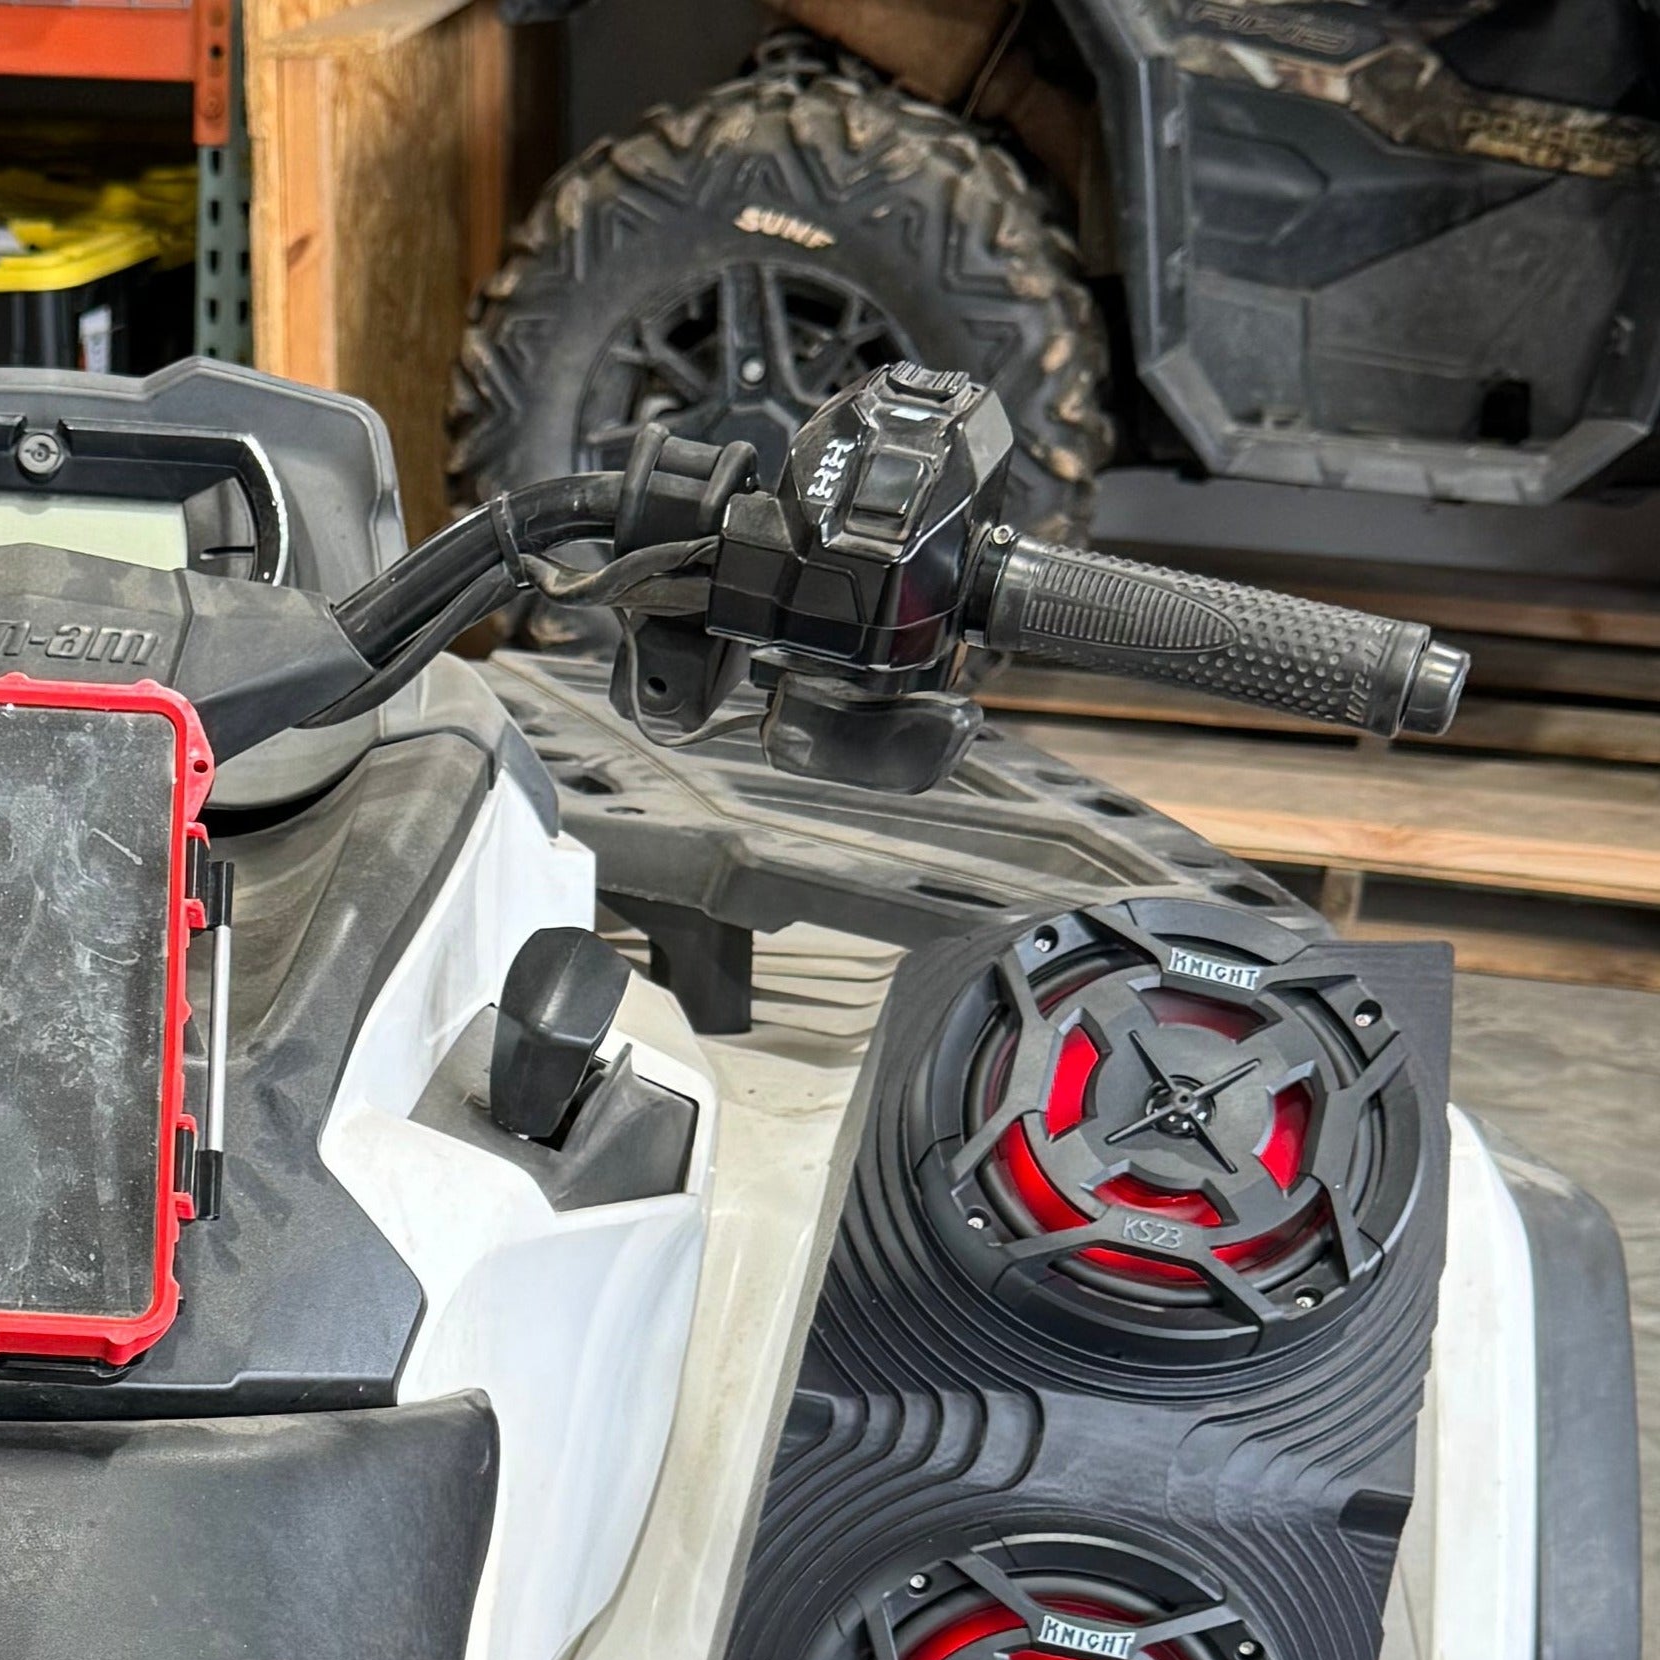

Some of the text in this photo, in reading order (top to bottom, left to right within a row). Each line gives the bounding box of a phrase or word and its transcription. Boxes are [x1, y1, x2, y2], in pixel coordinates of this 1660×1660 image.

[1171, 950, 1259, 988] KNIGHT
[1122, 1216, 1182, 1250] KS23
[1041, 1617, 1134, 1657] KNIGHT
